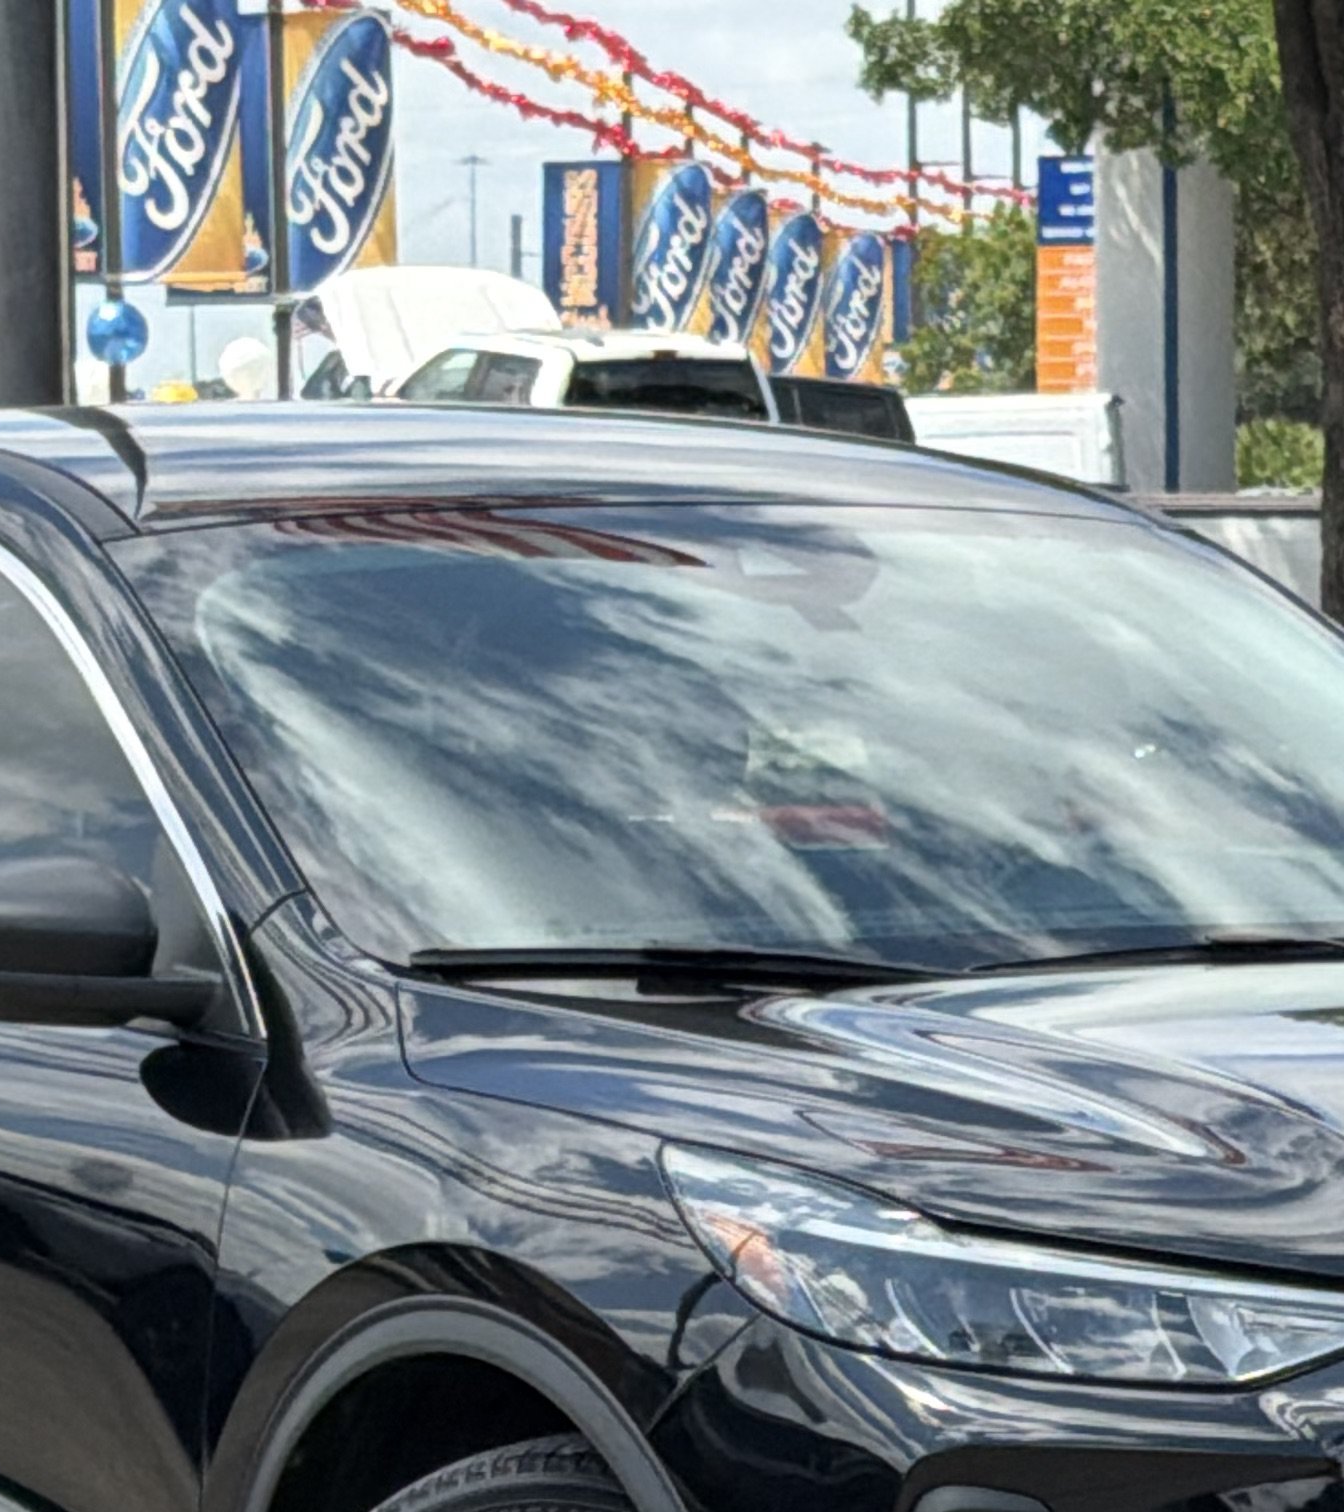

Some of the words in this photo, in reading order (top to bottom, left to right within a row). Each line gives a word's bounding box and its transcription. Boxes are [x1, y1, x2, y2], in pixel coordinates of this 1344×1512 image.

[117, 3, 234, 230] Ford
[287, 58, 389, 254] Ford
[632, 193, 707, 332] Ford
[711, 216, 765, 343] Ford
[768, 238, 819, 358] Ford
[826, 254, 881, 370] Ford
